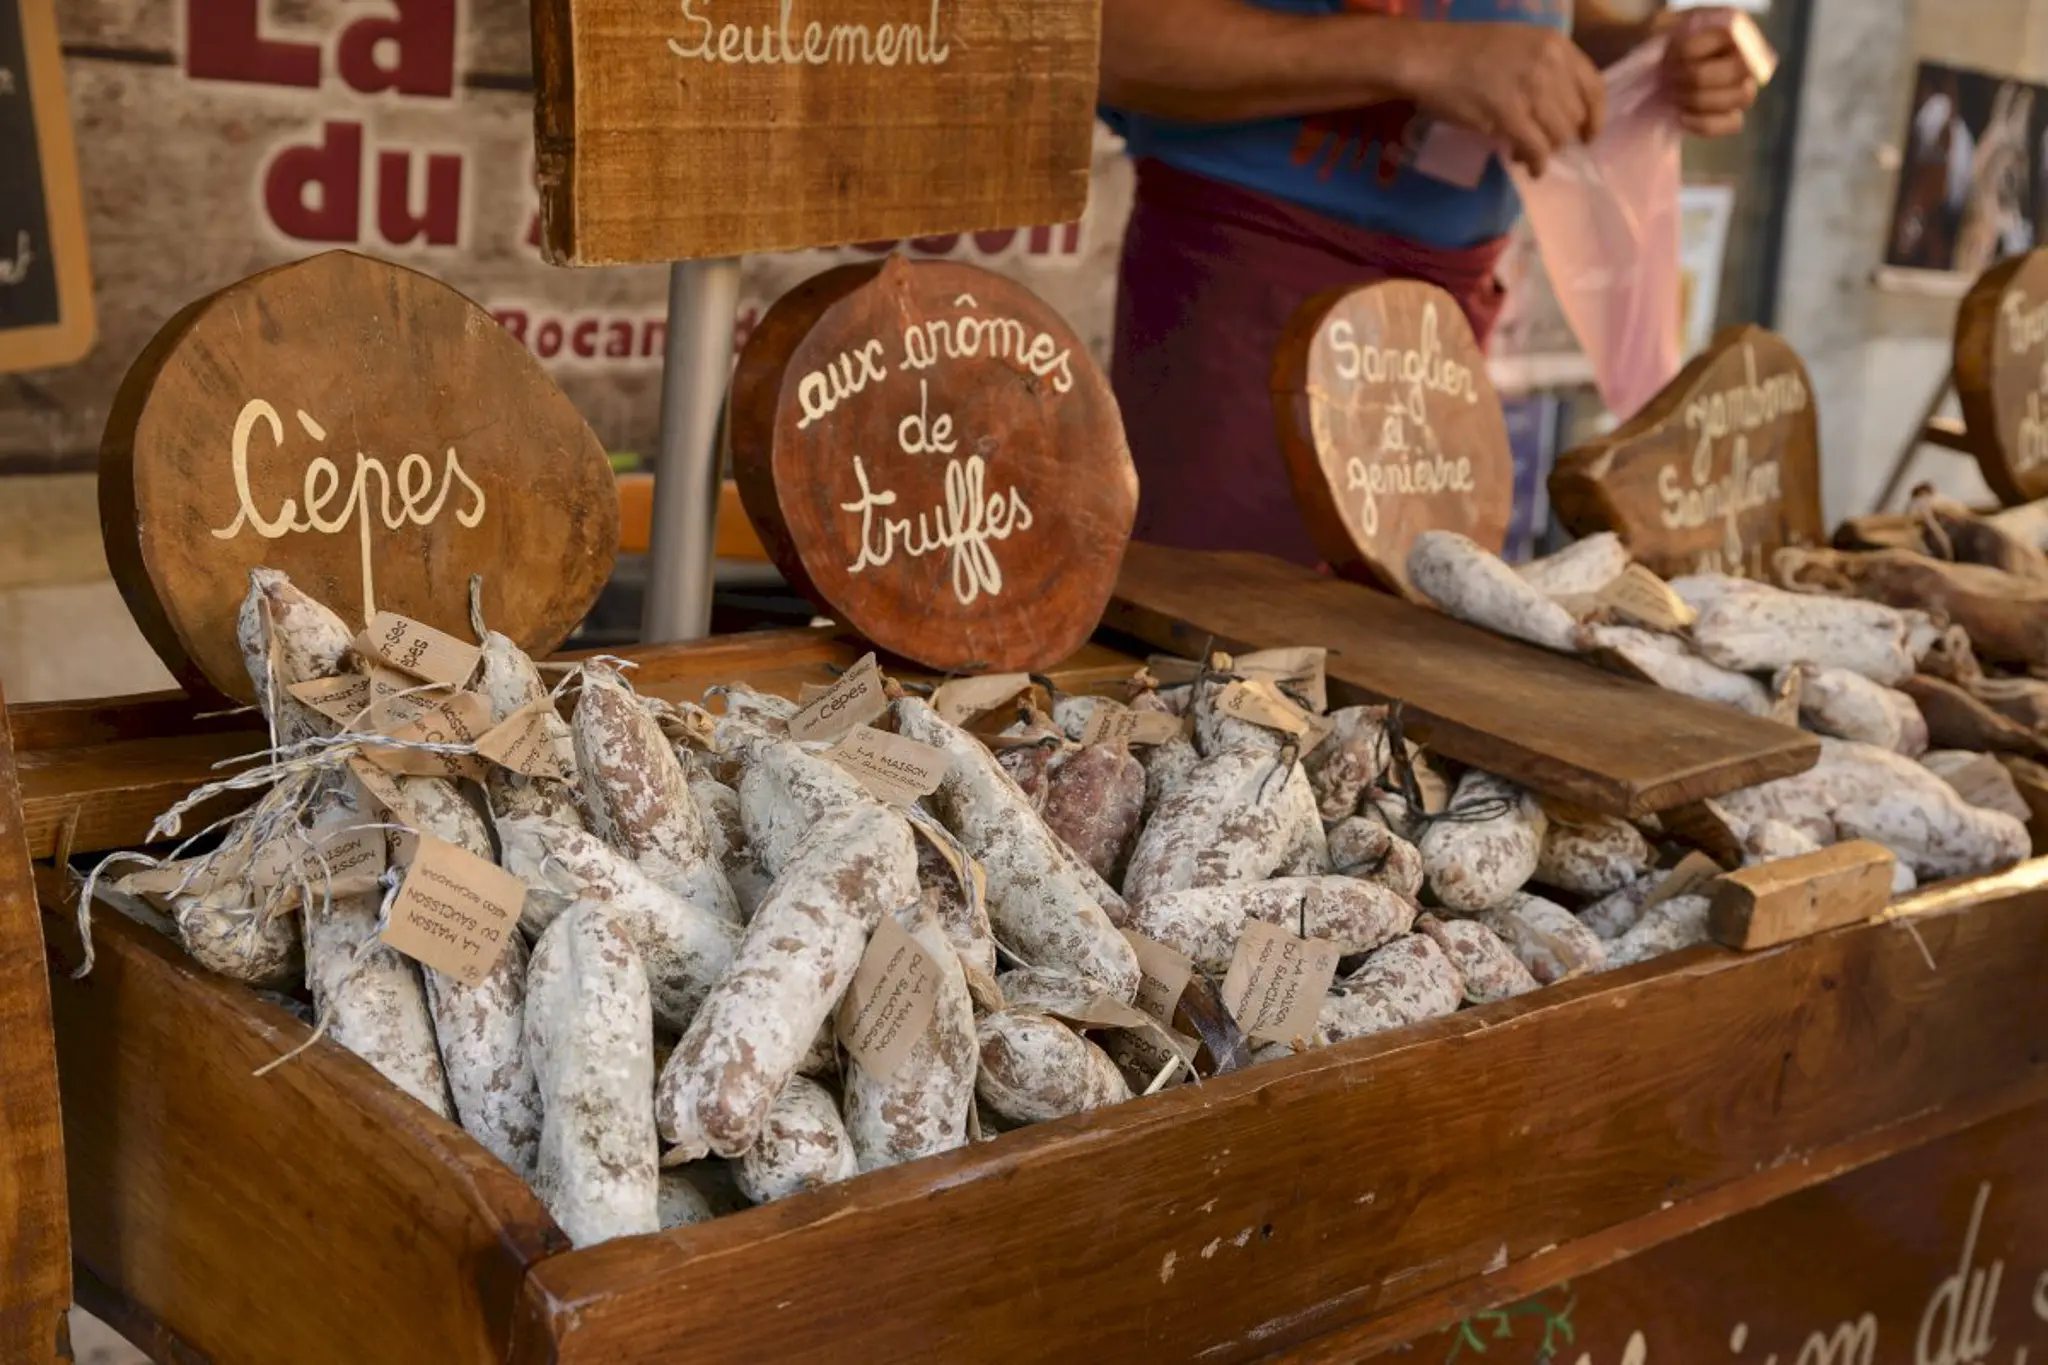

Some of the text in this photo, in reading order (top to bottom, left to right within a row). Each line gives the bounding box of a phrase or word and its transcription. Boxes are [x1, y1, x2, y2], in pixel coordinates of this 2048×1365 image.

[667, 0, 949, 66] Seulement
[264, 120, 462, 245] du
[797, 293, 1073, 430] aux arômes
[1329, 301, 1478, 424] Sanglier
[898, 378, 958, 454] de
[211, 398, 486, 628] Cèpes
[840, 454, 1033, 605] truffes
[820, 680, 868, 721] Cèpes
[880, 755, 929, 779] MAISON
[406, 886, 500, 943] DU SAUCISSON
[407, 909, 481, 956] LA MAISON
[859, 952, 923, 1053] DU SAUCISSON
[875, 973, 928, 1052] LA MAISON
[1254, 941, 1297, 1032] DU SAUCISSON
[1271, 957, 1307, 1027] LA MAISON
